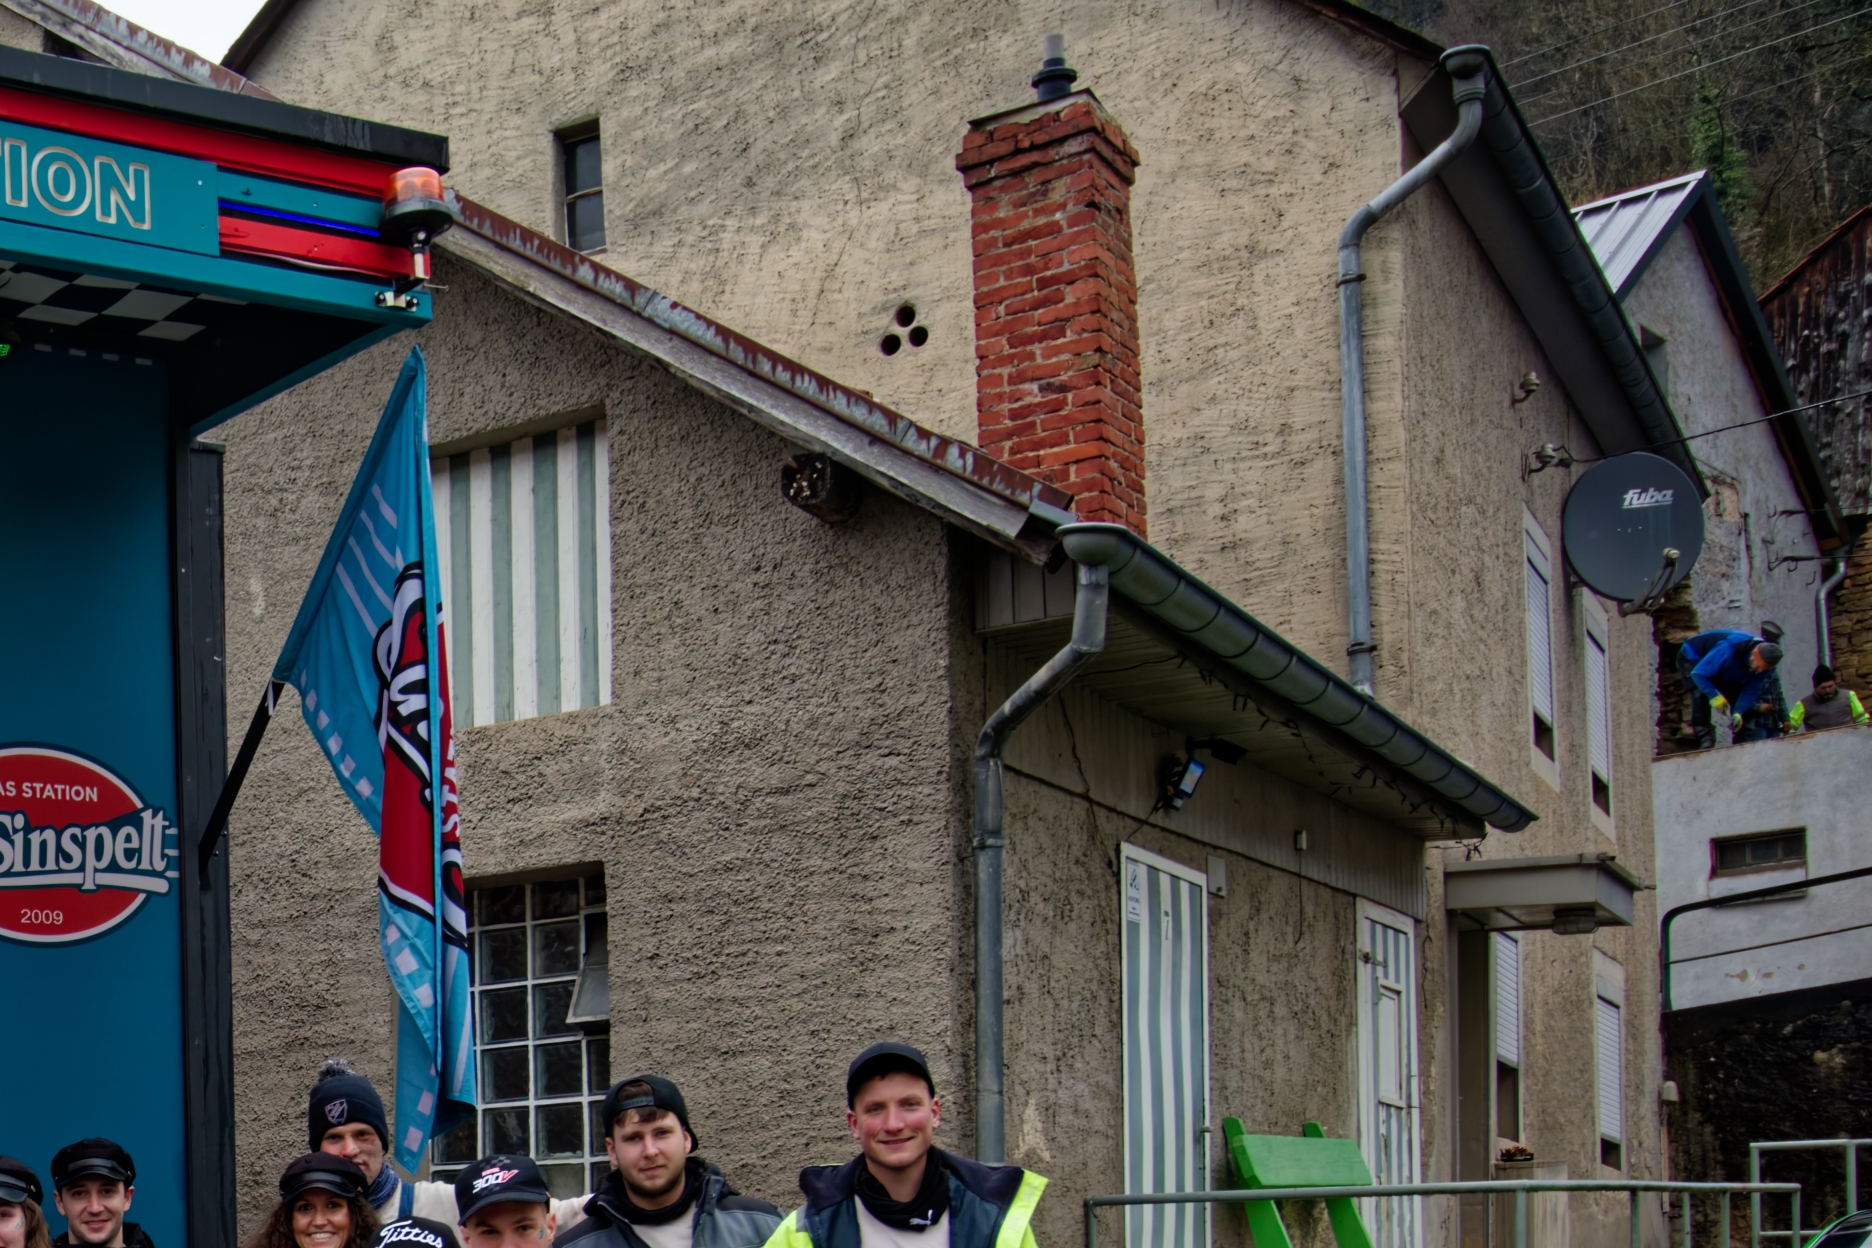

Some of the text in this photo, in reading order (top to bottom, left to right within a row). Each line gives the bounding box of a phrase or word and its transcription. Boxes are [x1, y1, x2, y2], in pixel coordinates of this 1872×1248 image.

[1622, 487, 1674, 507] fuba
[22, 782, 98, 802] STATION
[20, 908, 64, 925] 2009
[472, 1169, 520, 1194] 300V
